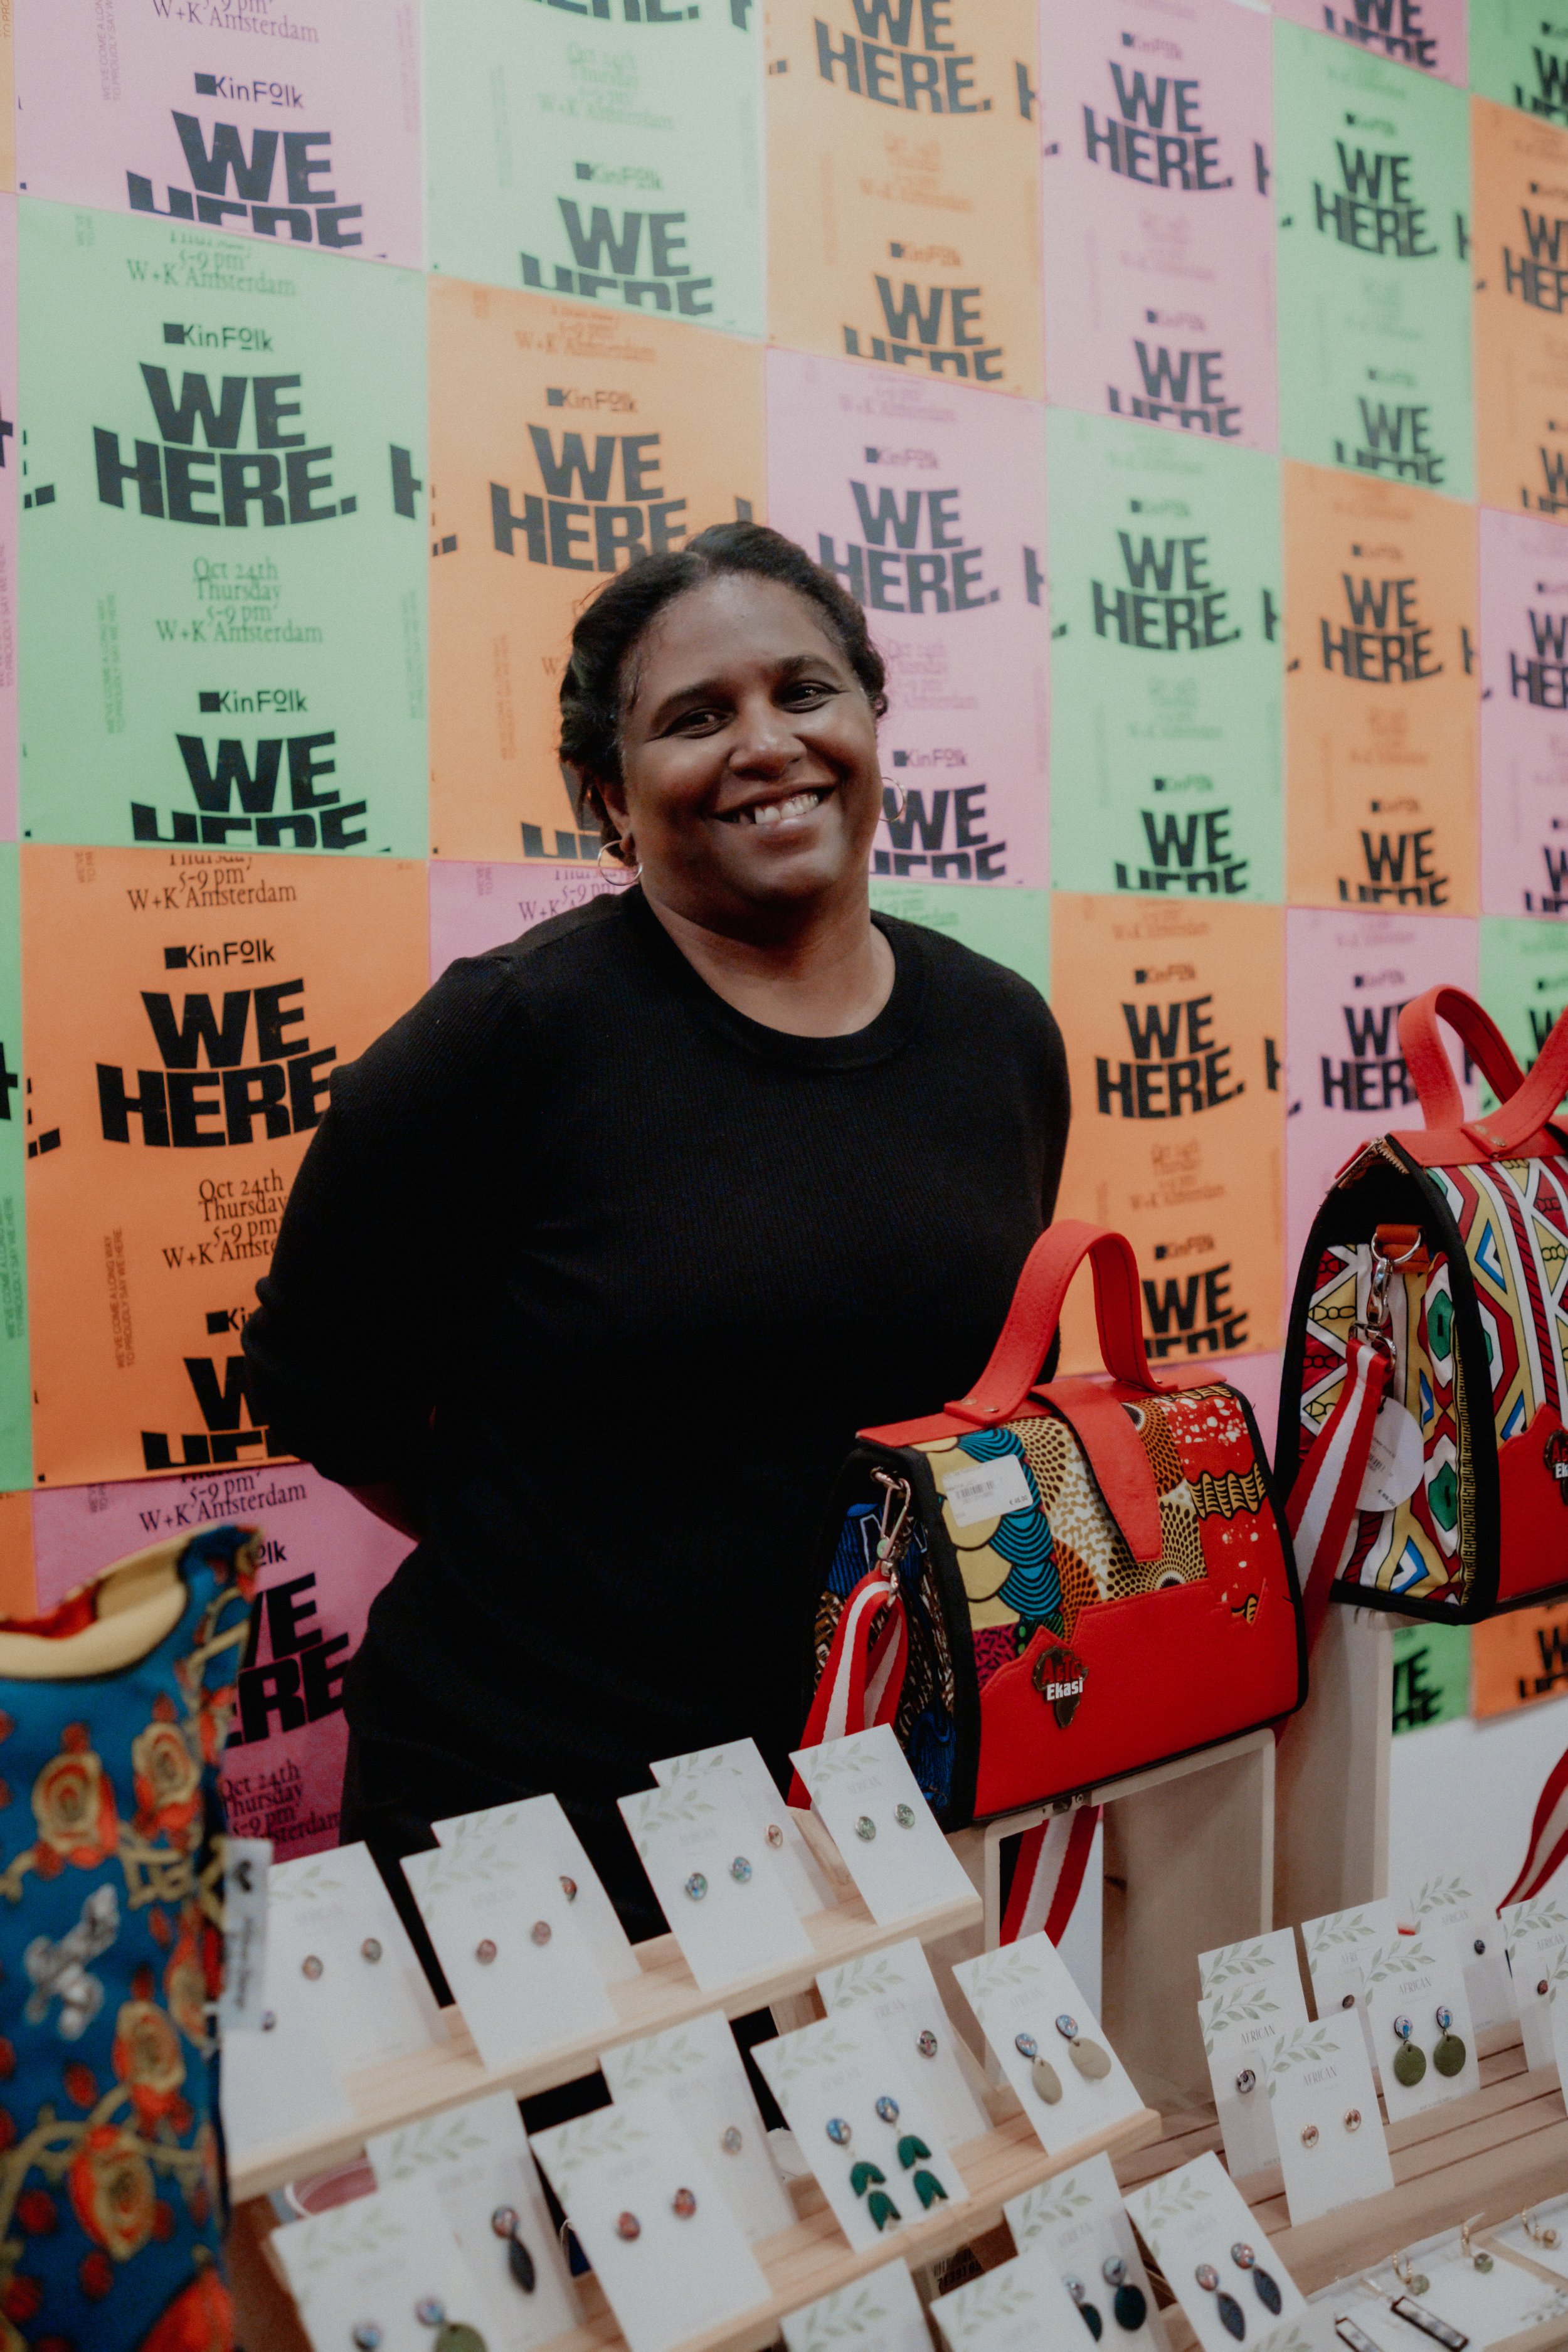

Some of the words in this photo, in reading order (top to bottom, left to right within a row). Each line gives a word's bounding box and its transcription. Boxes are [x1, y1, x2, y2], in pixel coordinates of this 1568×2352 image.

[3, 24, 11, 38] TO
[106, 12, 115, 31] SAY
[209, 4, 320, 42] Amsterdam
[850, 0, 955, 51] WE
[1353, 0, 1424, 37] WE
[97, 31, 108, 65] COME
[107, 35, 120, 85] PROUDLY
[813, 16, 991, 114] HERE.
[216, 76, 304, 109] KinFolk
[1108, 60, 1202, 132] WE
[171, 110, 336, 204] WE
[1083, 103, 1232, 190] HERE.
[1336, 139, 1412, 203] WE
[558, 196, 690, 277] WE
[1314, 181, 1438, 258] HERE.
[179, 250, 209, 270] 5-9
[215, 252, 249, 272] pm
[186, 264, 297, 296] Amsterdam
[874, 273, 984, 346] WE
[183, 324, 273, 352] KinFolk
[1134, 339, 1225, 403] WE
[139, 362, 305, 449] WE
[1358, 396, 1431, 454] WE
[93, 426, 358, 527] HERE.
[526, 423, 664, 502] WE
[849, 479, 963, 550] WE
[193, 556, 228, 582] Oct
[235, 556, 279, 581] 24th
[818, 532, 1000, 614] HERE.
[1117, 530, 1210, 591] WE
[196, 578, 282, 604] Thursday
[1342, 571, 1418, 628] WE
[206, 605, 237, 623] 5-9
[241, 606, 272, 627] pm
[214, 618, 324, 644] Amsterdam
[1091, 580, 1241, 650] HERE.
[1320, 617, 1443, 684] HERE.
[219, 689, 308, 712] KinFolk
[176, 731, 341, 813] WE
[881, 784, 988, 851] WE
[1141, 808, 1233, 868] WE
[1360, 827, 1436, 882] WE
[127, 887, 180, 911] W+K
[186, 880, 297, 909] Amsterdam
[178, 872, 209, 892] 5-9
[214, 868, 245, 887] pm
[186, 940, 276, 968] KinFolk
[140, 977, 310, 1069] WE
[1122, 993, 1216, 1060] WE
[1095, 1046, 1245, 1120] HERE.
[198, 1178, 234, 1202] Oct
[240, 1168, 285, 1196] 24th
[103, 1235, 114, 1259] WAY
[112, 1227, 124, 1258] HERE
[213, 1223, 243, 1246] 5-9
[247, 1217, 278, 1241] pm
[115, 1259, 125, 1276] WE
[162, 1243, 214, 1269] W+K
[105, 1260, 117, 1292] LONG
[117, 1279, 128, 1300] SAY
[1143, 1262, 1233, 1335] WE
[109, 1301, 121, 1335] COME
[121, 1301, 132, 1350] PROUDLY
[125, 1351, 134, 1367] TO
[139, 1502, 191, 1532] W+K
[197, 1481, 307, 1522] Amsterdam
[189, 1484, 220, 1503] 5-9
[225, 1475, 256, 1496] pm
[1047, 1677, 1084, 1701] Ekasi
[258, 1759, 301, 1789] 24th
[265, 1806, 295, 1835] pm
[1537, 1932, 1565, 1951] AFRICAN
[1398, 1976, 1432, 1995] AFRICAN
[1241, 2024, 1276, 2045] AFRICAN
[1303, 2065, 1337, 2087] AFRICAN
